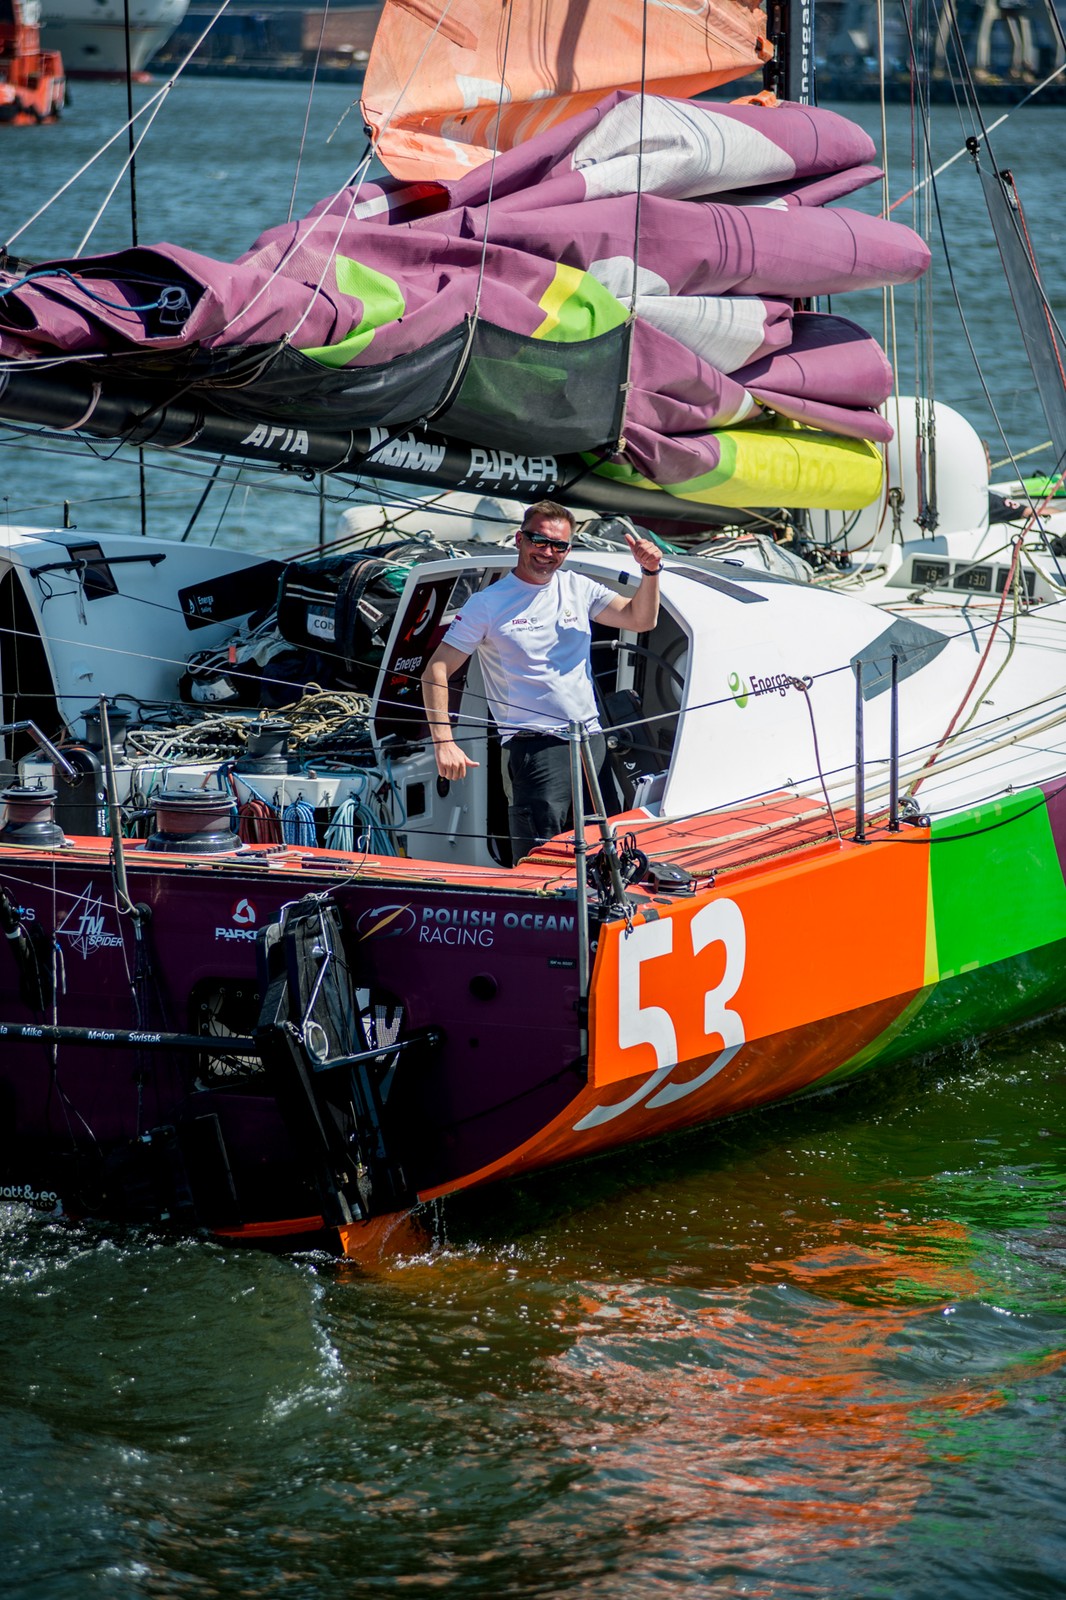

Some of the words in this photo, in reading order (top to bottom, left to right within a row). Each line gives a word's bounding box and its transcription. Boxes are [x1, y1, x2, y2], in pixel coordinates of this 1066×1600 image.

[367, 427, 446, 473] Marlow
[465, 448, 558, 482] PARKER
[457, 479, 556, 493] POLAND
[393, 656, 422, 672] Energa
[422, 907, 496, 927] POLISH
[503, 912, 575, 932] OCEAN
[89, 935, 124, 947] SPIDER
[215, 927, 258, 940] PARK
[418, 925, 494, 947] RACING
[572, 897, 747, 1131] 53
[21, 1026, 43, 1037] Mike
